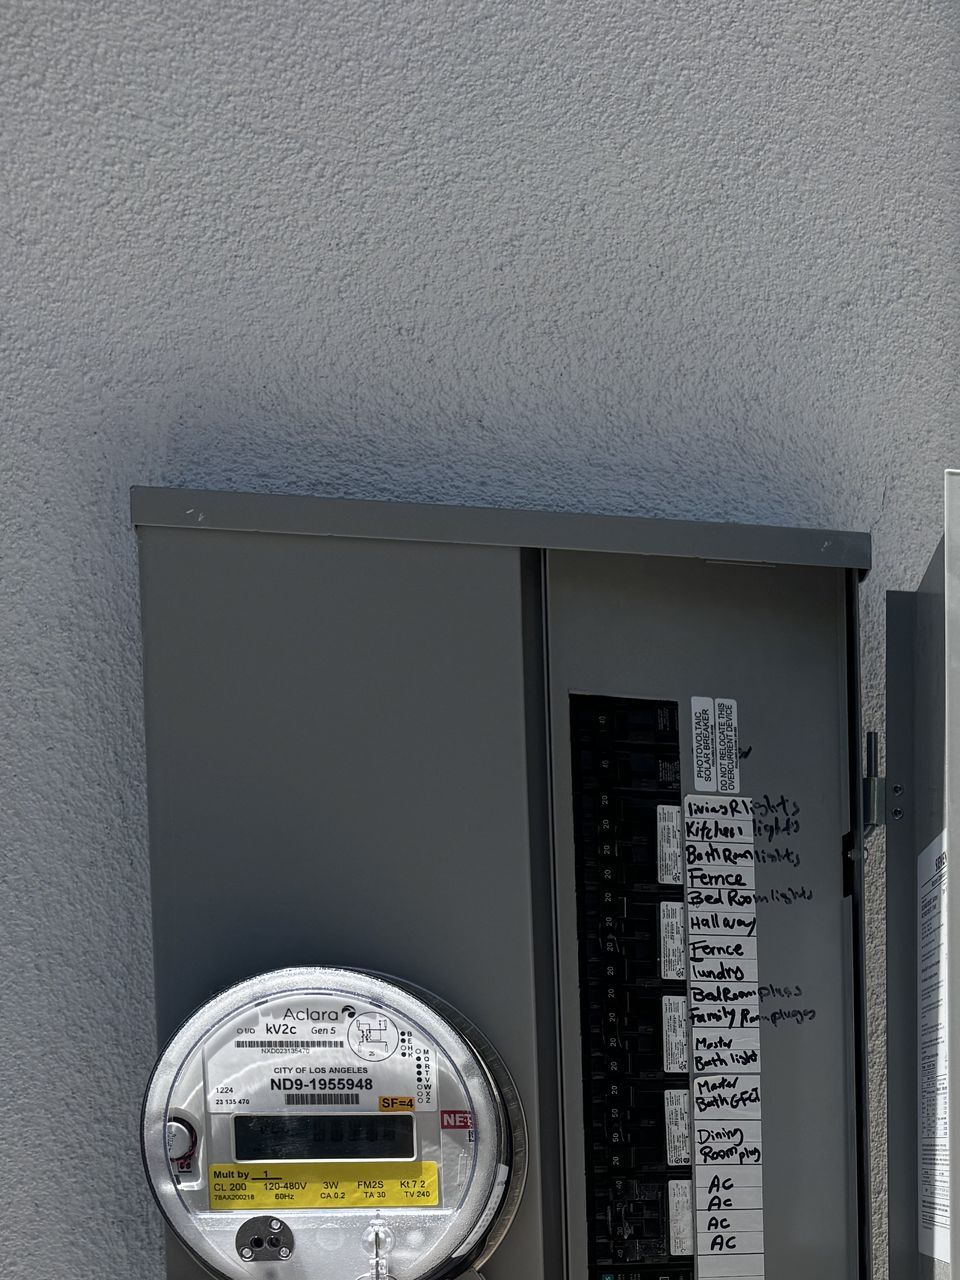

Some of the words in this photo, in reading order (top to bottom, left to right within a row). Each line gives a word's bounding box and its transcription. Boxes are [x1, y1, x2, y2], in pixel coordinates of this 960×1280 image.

[717, 702, 726, 719] THIS
[725, 704, 733, 732] DEVICE
[701, 708, 710, 750] BREAKER
[694, 711, 703, 778] PHOTOVOLTAIC
[718, 721, 727, 760] RELOCATE
[703, 752, 711, 781] SOLAR
[719, 762, 728, 778] NOT
[726, 734, 734, 790] OVERCURRENT
[720, 779, 727, 791] DO
[282, 1007, 339, 1021] Aclara
[265, 1022, 297, 1035] kV2c
[311, 1026, 328, 1035] Gen
[330, 1026, 336, 1034] 5
[270, 1078, 372, 1090] ND9-1955948
[381, 1097, 414, 1109] SF=4
[213, 1170, 234, 1180] Mult
[237, 1170, 249, 1181] by
[263, 1171, 269, 1179] 1
[213, 1183, 227, 1191] CL
[229, 1183, 247, 1191] 200
[264, 1182, 307, 1191] 120-480V
[322, 1181, 339, 1189] 3W
[357, 1180, 384, 1189] FM2S
[708, 1175, 734, 1194] AC
[707, 1196, 732, 1211] AC
[707, 1217, 730, 1231] AC
[711, 1234, 736, 1251] AC
